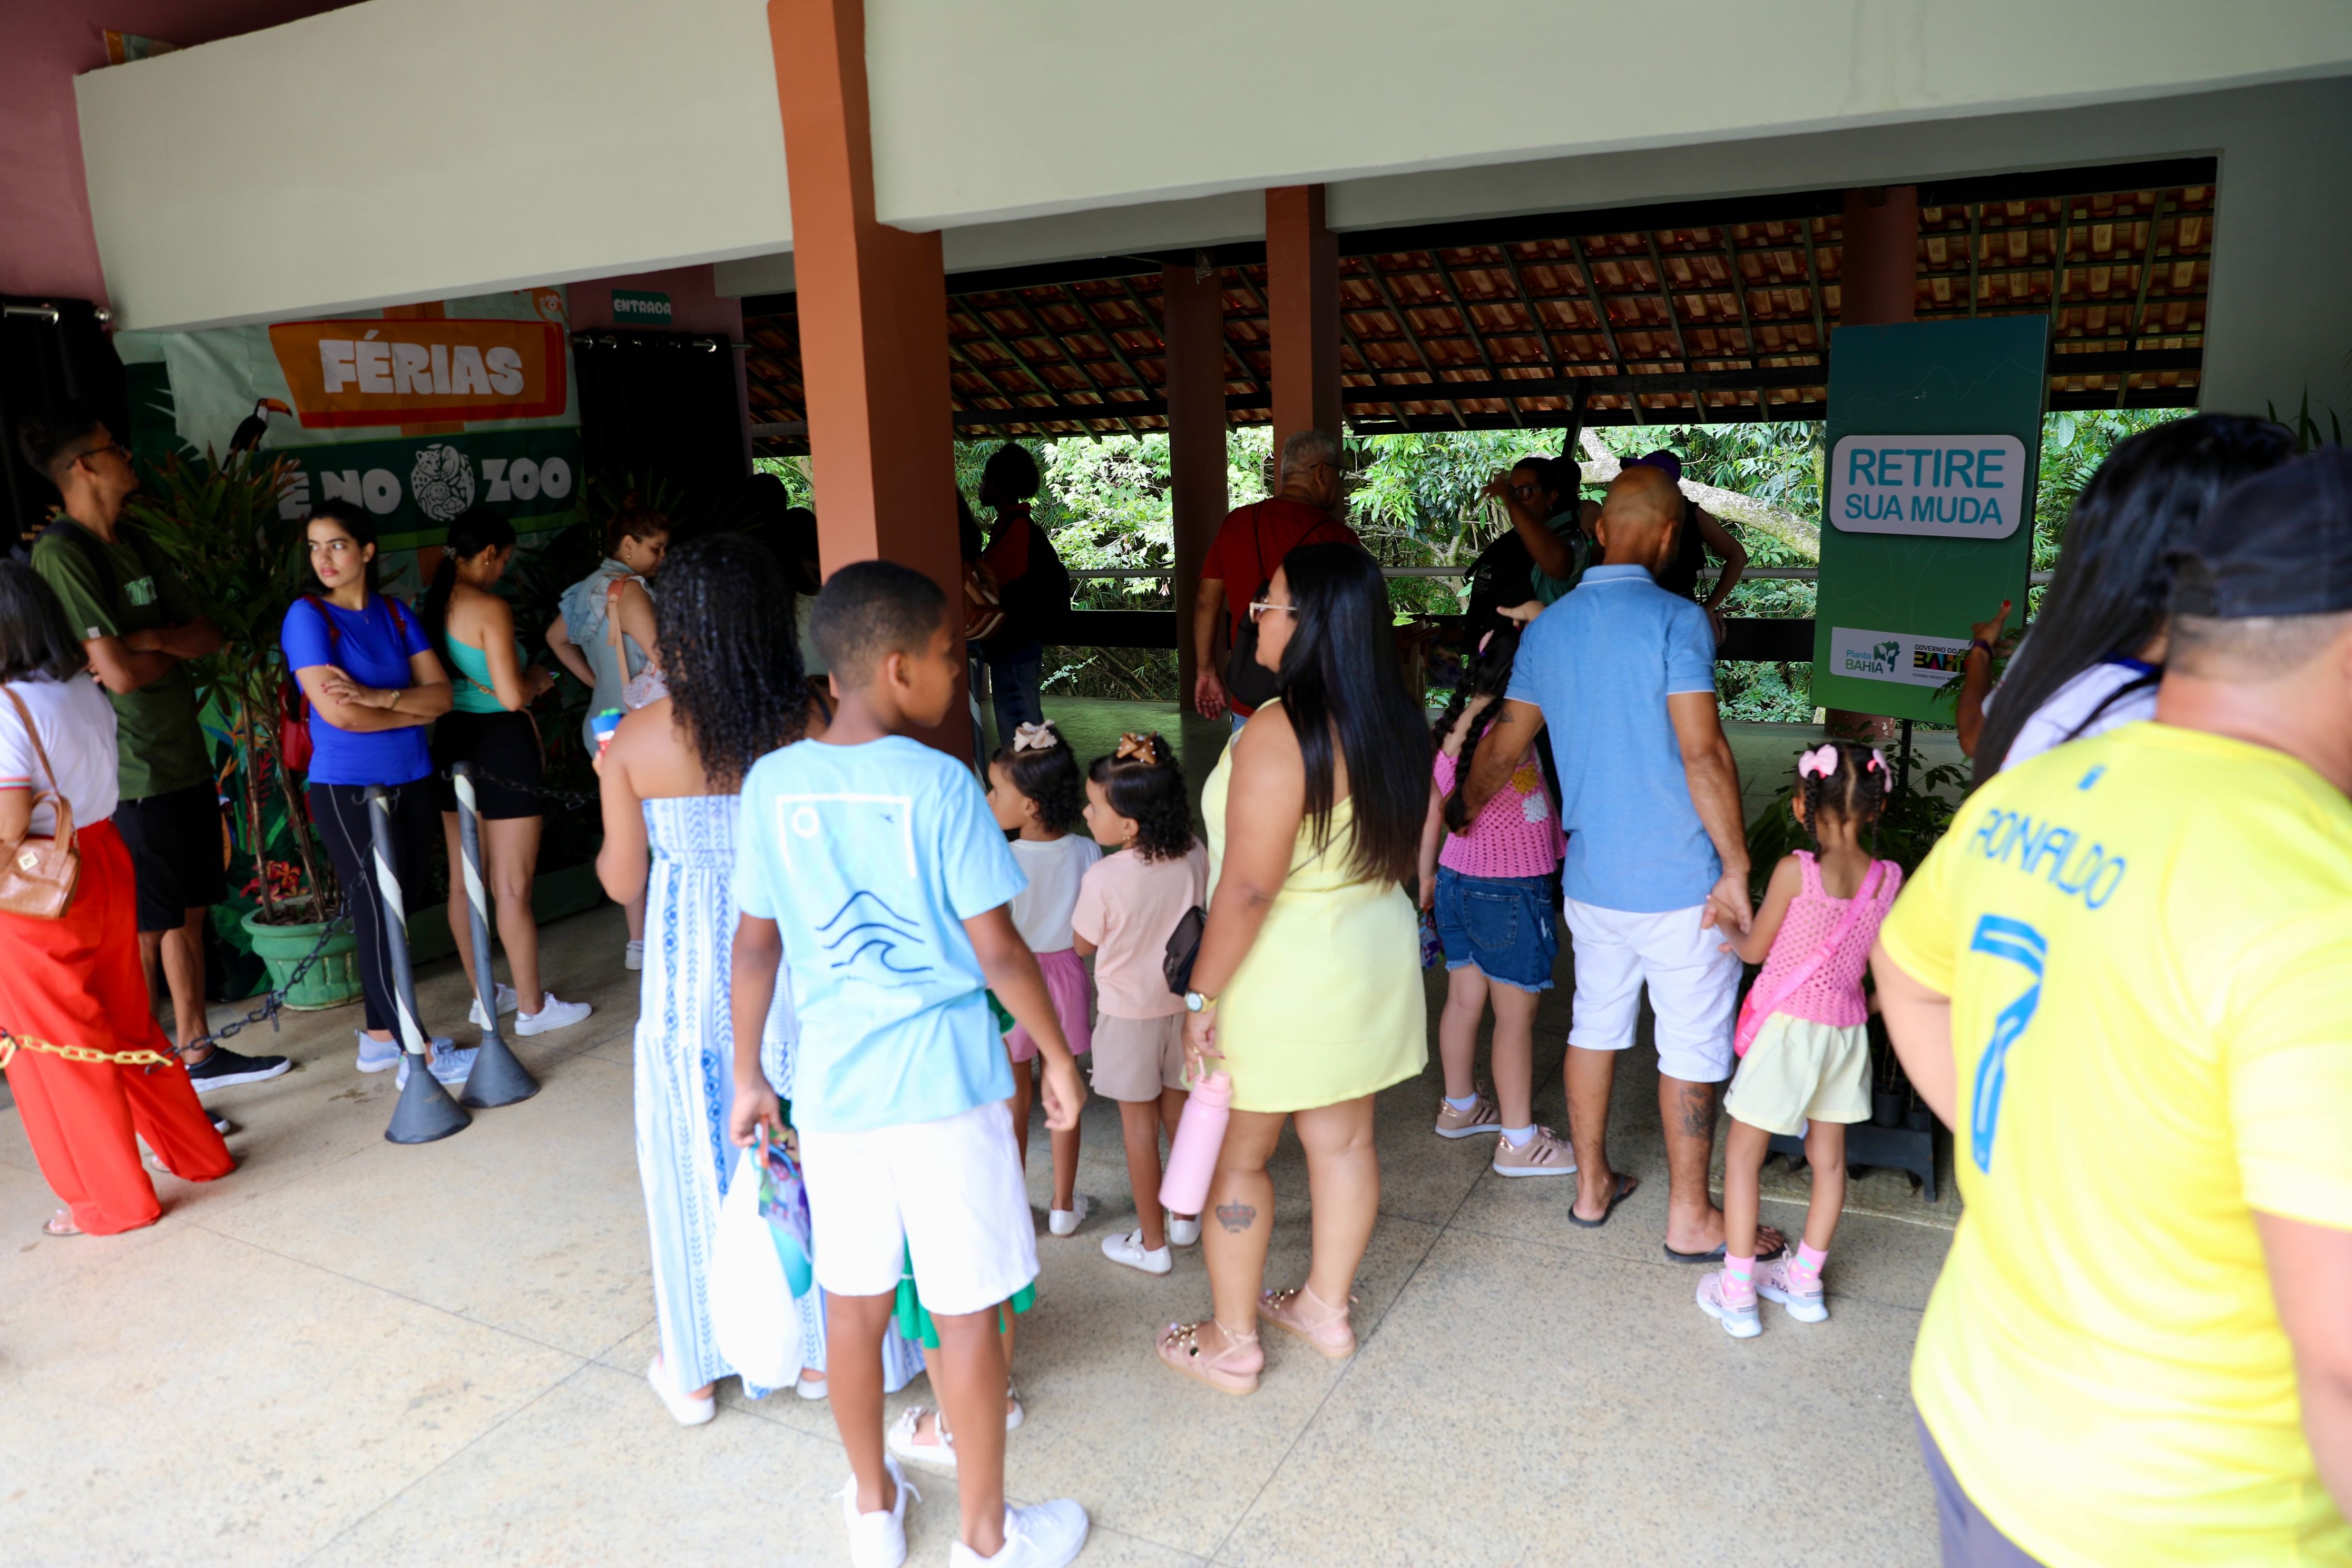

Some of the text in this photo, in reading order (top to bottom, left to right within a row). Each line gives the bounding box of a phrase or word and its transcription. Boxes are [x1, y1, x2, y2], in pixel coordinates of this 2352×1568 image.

[614, 298, 671, 315] ENTRADA
[318, 329, 524, 396] FÉRIAS
[320, 468, 402, 514] NO
[482, 456, 572, 502] ZOO
[1849, 448, 2006, 488] RETIRE
[1845, 493, 2002, 525] SUA MUDA
[1845, 659, 1884, 674] BAHIA
[1846, 649, 1871, 659] Planta
[1914, 644, 1946, 653] GOVERNO
[1968, 808, 2127, 910] RONALDO
[1969, 914, 2048, 1175] 7
